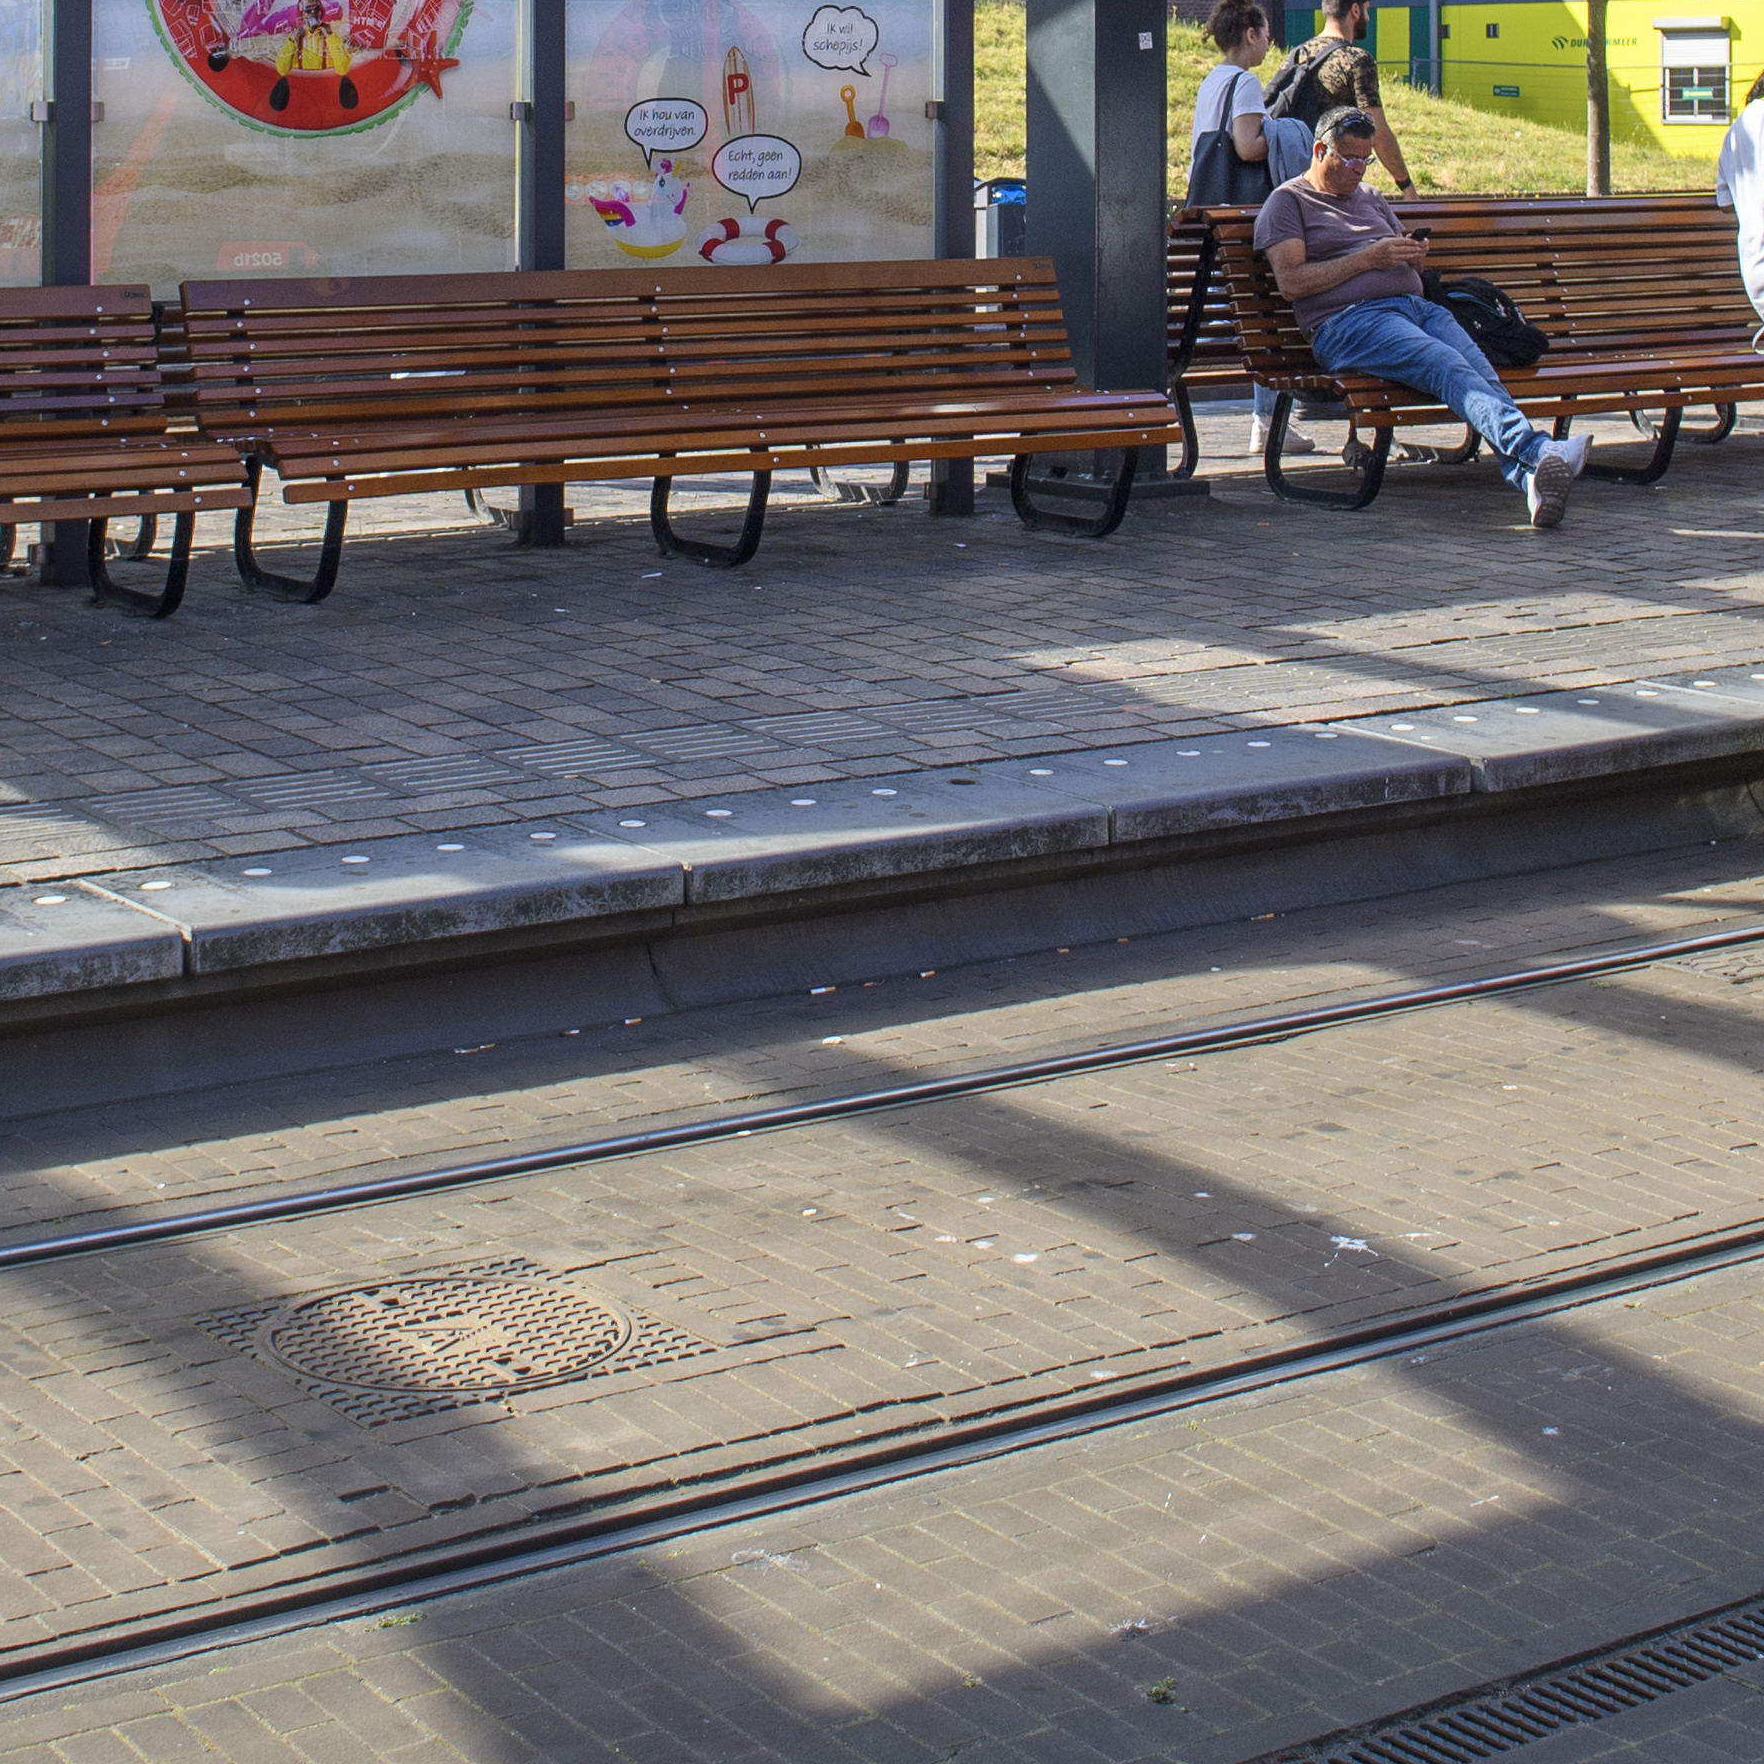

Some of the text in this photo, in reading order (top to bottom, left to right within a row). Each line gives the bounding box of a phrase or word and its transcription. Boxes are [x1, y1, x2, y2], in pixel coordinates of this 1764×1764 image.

[838, 22, 854, 34] wil
[812, 38, 863, 56] schepijs!
[727, 72, 749, 106] P
[652, 108, 672, 121] hou
[674, 111, 695, 121] van
[633, 124, 697, 140] overdrijven.
[728, 149, 784, 167] Echt, geen
[728, 167, 793, 181] redden aan!
